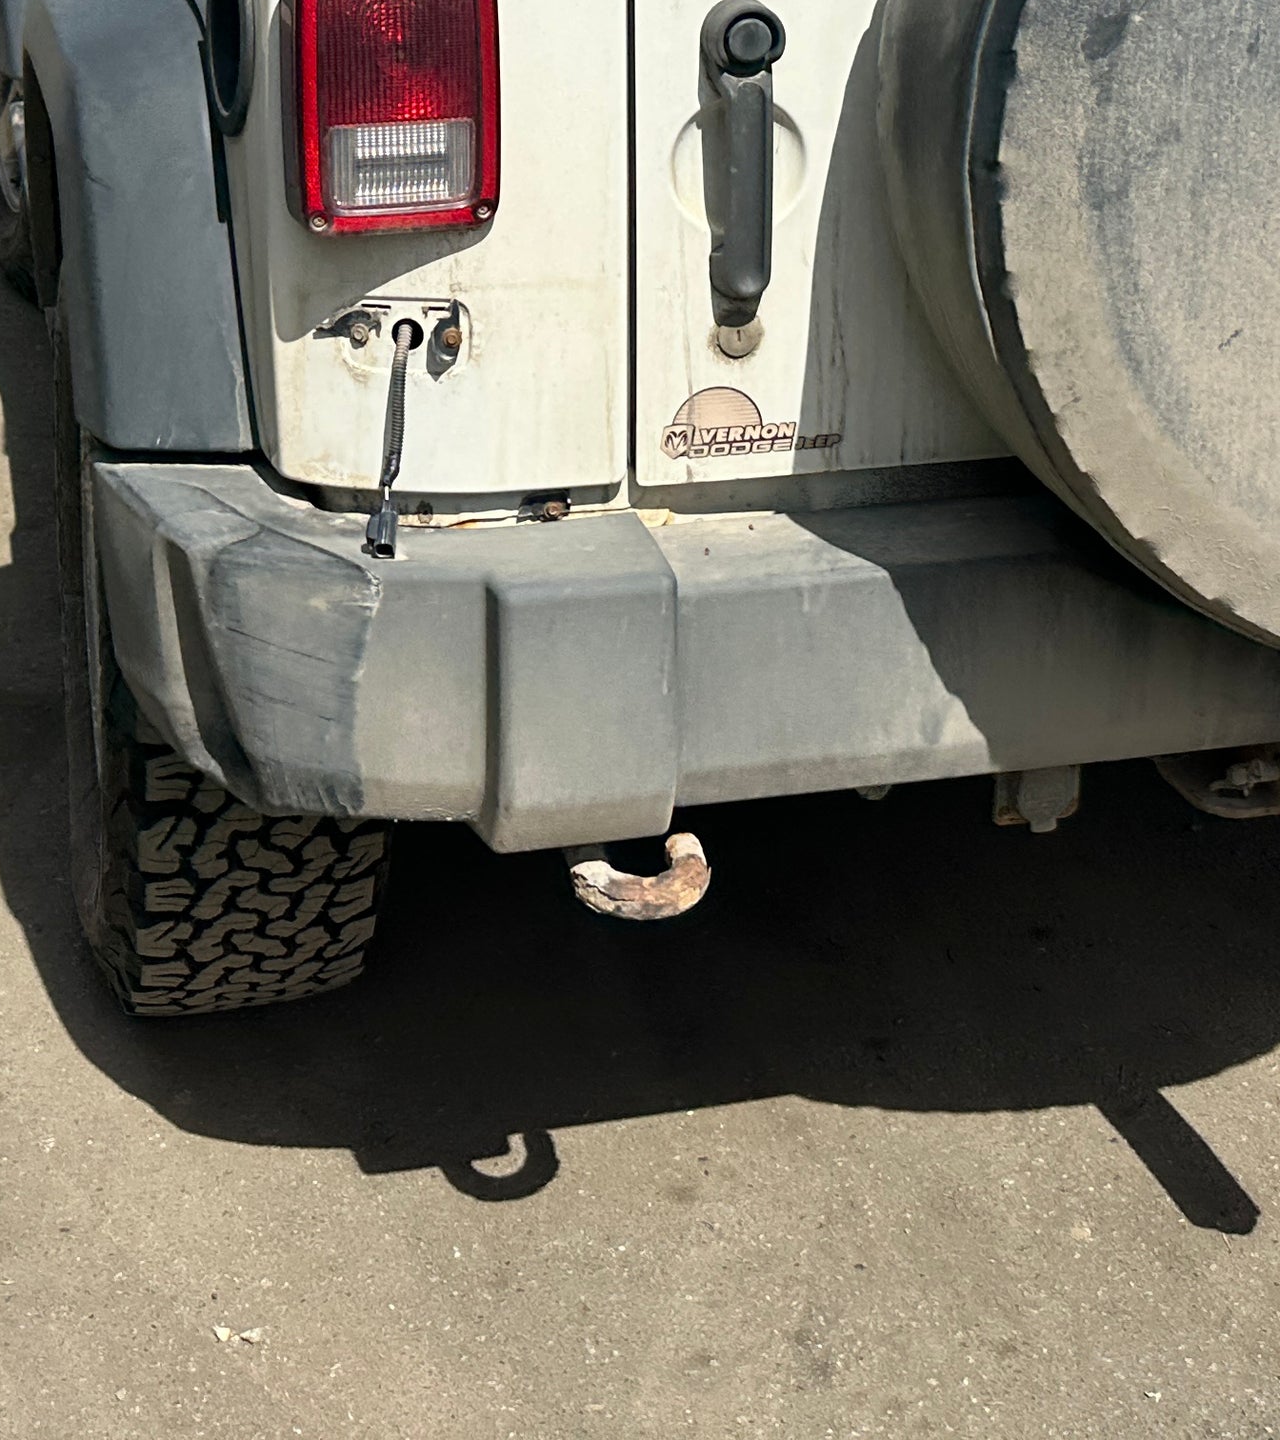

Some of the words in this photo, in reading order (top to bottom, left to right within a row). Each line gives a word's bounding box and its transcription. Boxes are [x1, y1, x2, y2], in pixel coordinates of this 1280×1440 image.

[698, 422, 796, 444] VERNON
[689, 438, 794, 458] DODGE
[795, 434, 841, 450] JEEP
